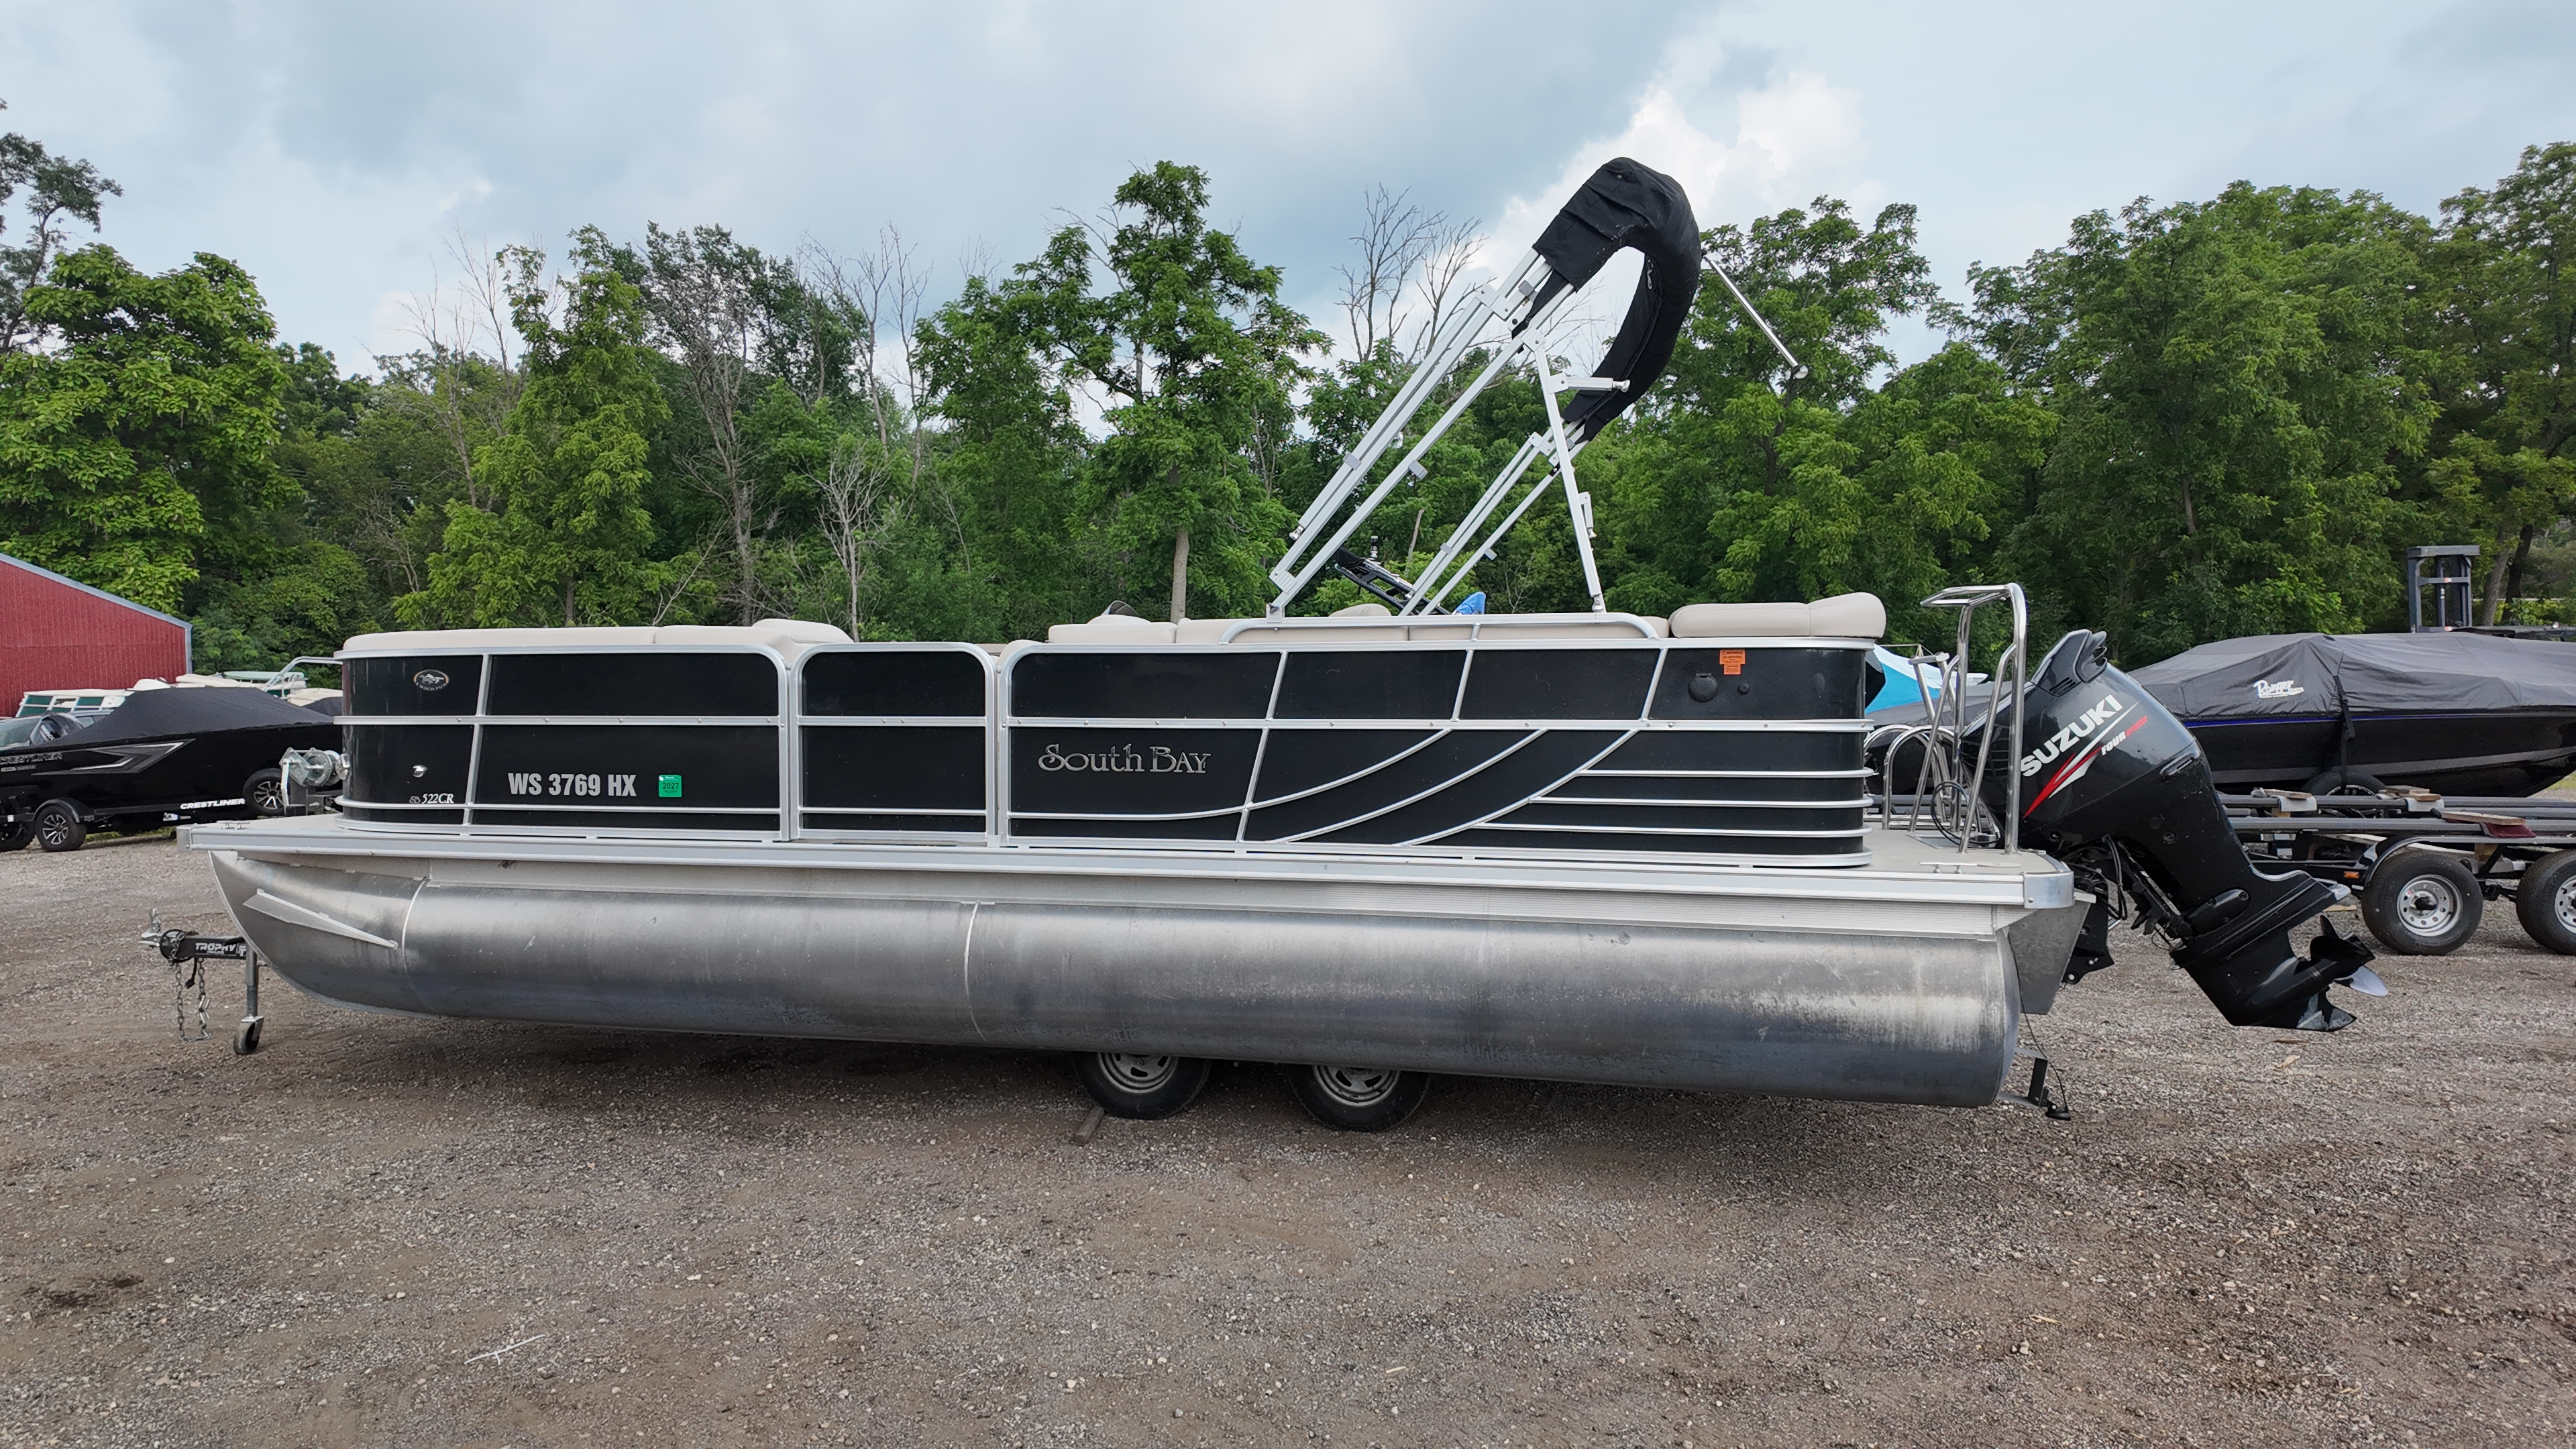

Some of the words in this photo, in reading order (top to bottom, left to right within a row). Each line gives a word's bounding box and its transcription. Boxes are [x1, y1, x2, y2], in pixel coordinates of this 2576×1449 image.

[2253, 680, 2294, 698] Ranger
[2020, 694, 2123, 777] SUZUKI
[2101, 731, 2127, 756] FOUR
[1038, 743, 1145, 771] South
[1149, 746, 1212, 773] BAY
[508, 772, 542, 796] WS
[548, 773, 601, 796] 3769
[608, 774, 637, 797] HX
[180, 798, 246, 810] CRESTLINER
[421, 793, 455, 804] 522CR
[195, 943, 237, 951] TROPHY
